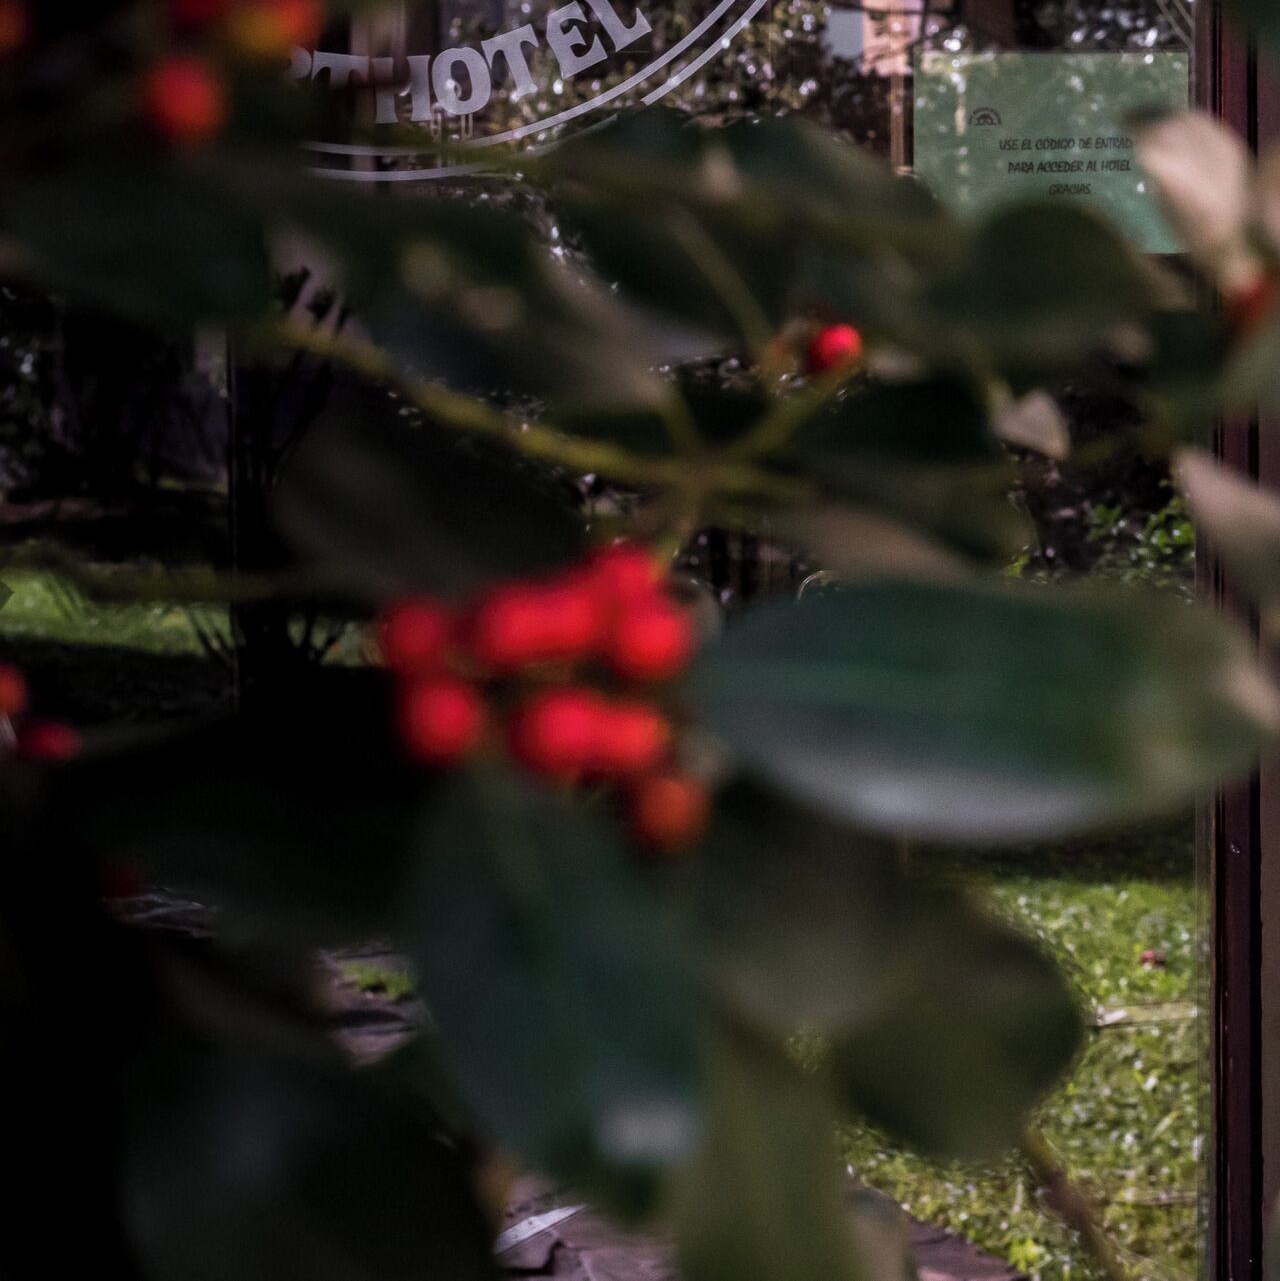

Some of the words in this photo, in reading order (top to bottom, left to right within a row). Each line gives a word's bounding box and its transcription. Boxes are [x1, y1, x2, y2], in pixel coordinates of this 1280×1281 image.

[999, 137, 1019, 151] USE
[1021, 138, 1032, 151] EL
[1078, 137, 1092, 150] DE
[1094, 137, 1134, 150] ENTRAD
[1008, 161, 1034, 174] PARA
[1036, 160, 1084, 173] ACCEDER
[1086, 160, 1098, 172] AL
[1101, 159, 1132, 172] HOTEL
[1048, 183, 1091, 195] GRACIAS
